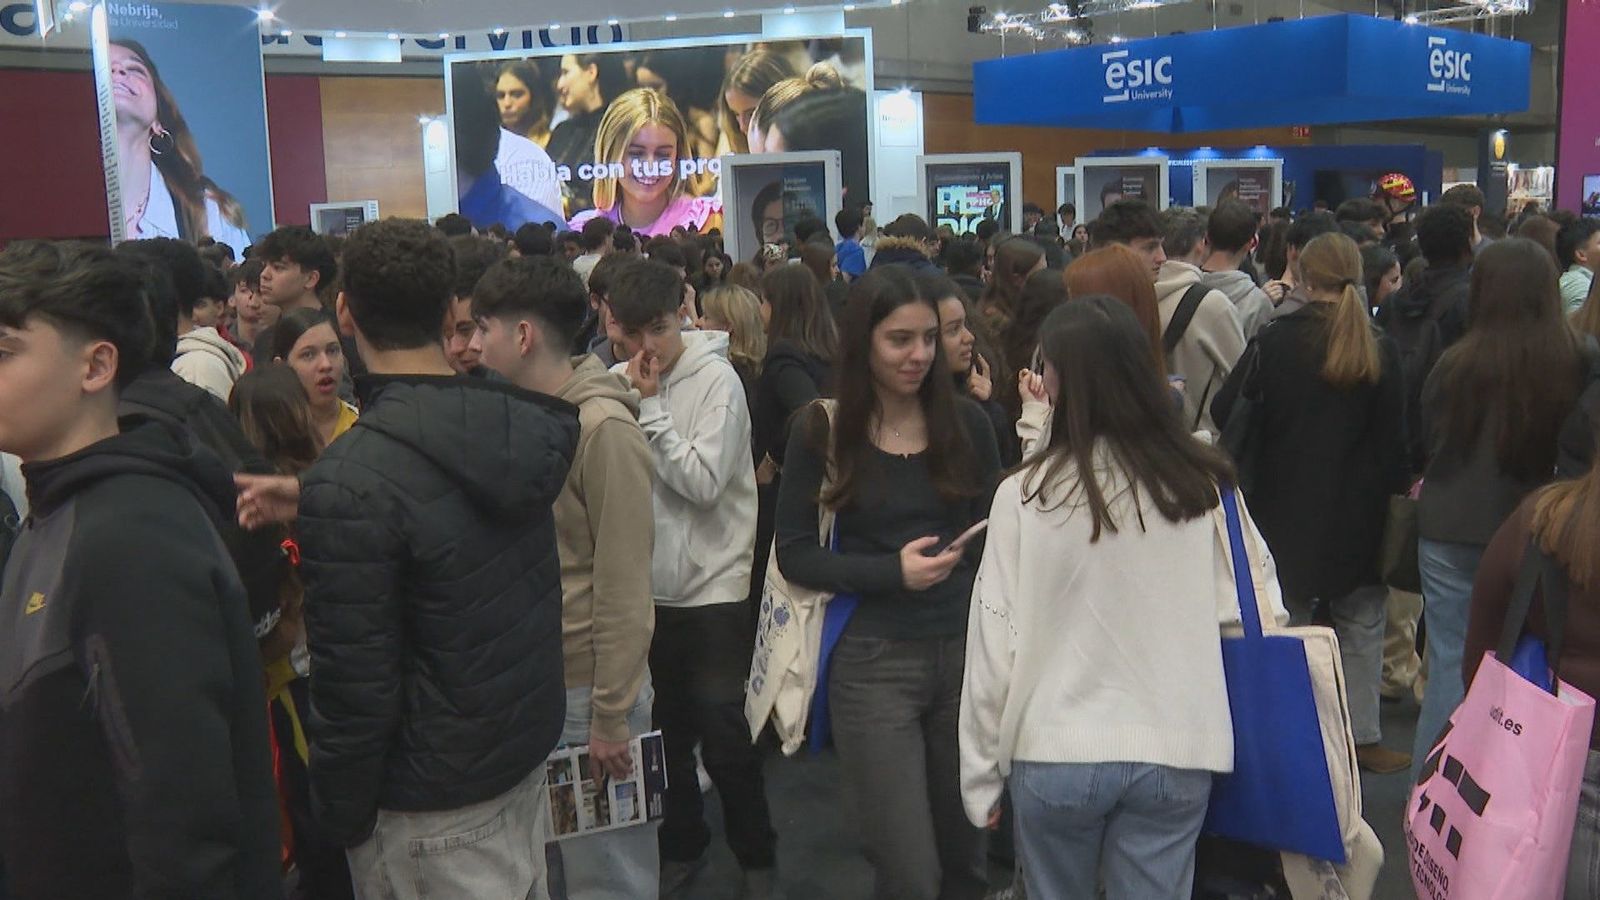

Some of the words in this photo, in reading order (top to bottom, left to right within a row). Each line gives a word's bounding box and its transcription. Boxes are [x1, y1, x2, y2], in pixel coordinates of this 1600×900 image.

[108, 2, 163, 19] Nebrija,
[1131, 88, 1173, 101] University
[1446, 81, 1471, 96] University
[500, 161, 572, 185] Habla
[577, 162, 625, 180] con
[631, 157, 674, 178] tus
